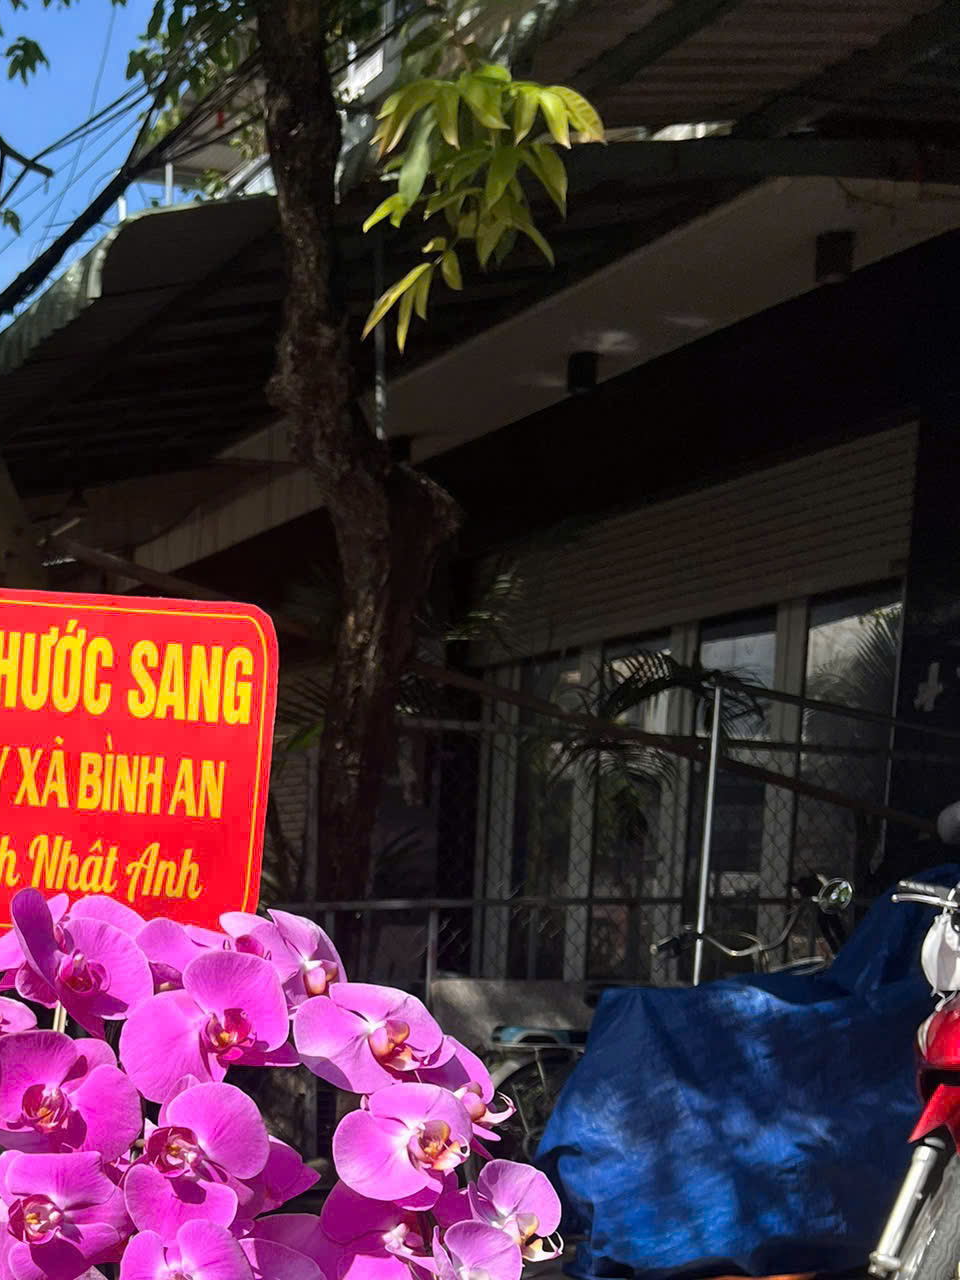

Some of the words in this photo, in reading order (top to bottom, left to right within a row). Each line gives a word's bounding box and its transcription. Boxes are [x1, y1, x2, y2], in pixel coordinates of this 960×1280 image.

[127, 640, 255, 725] SANG
[77, 733, 164, 815] BÌNH
[168, 758, 225, 818] AN
[125, 842, 203, 902] Anh
